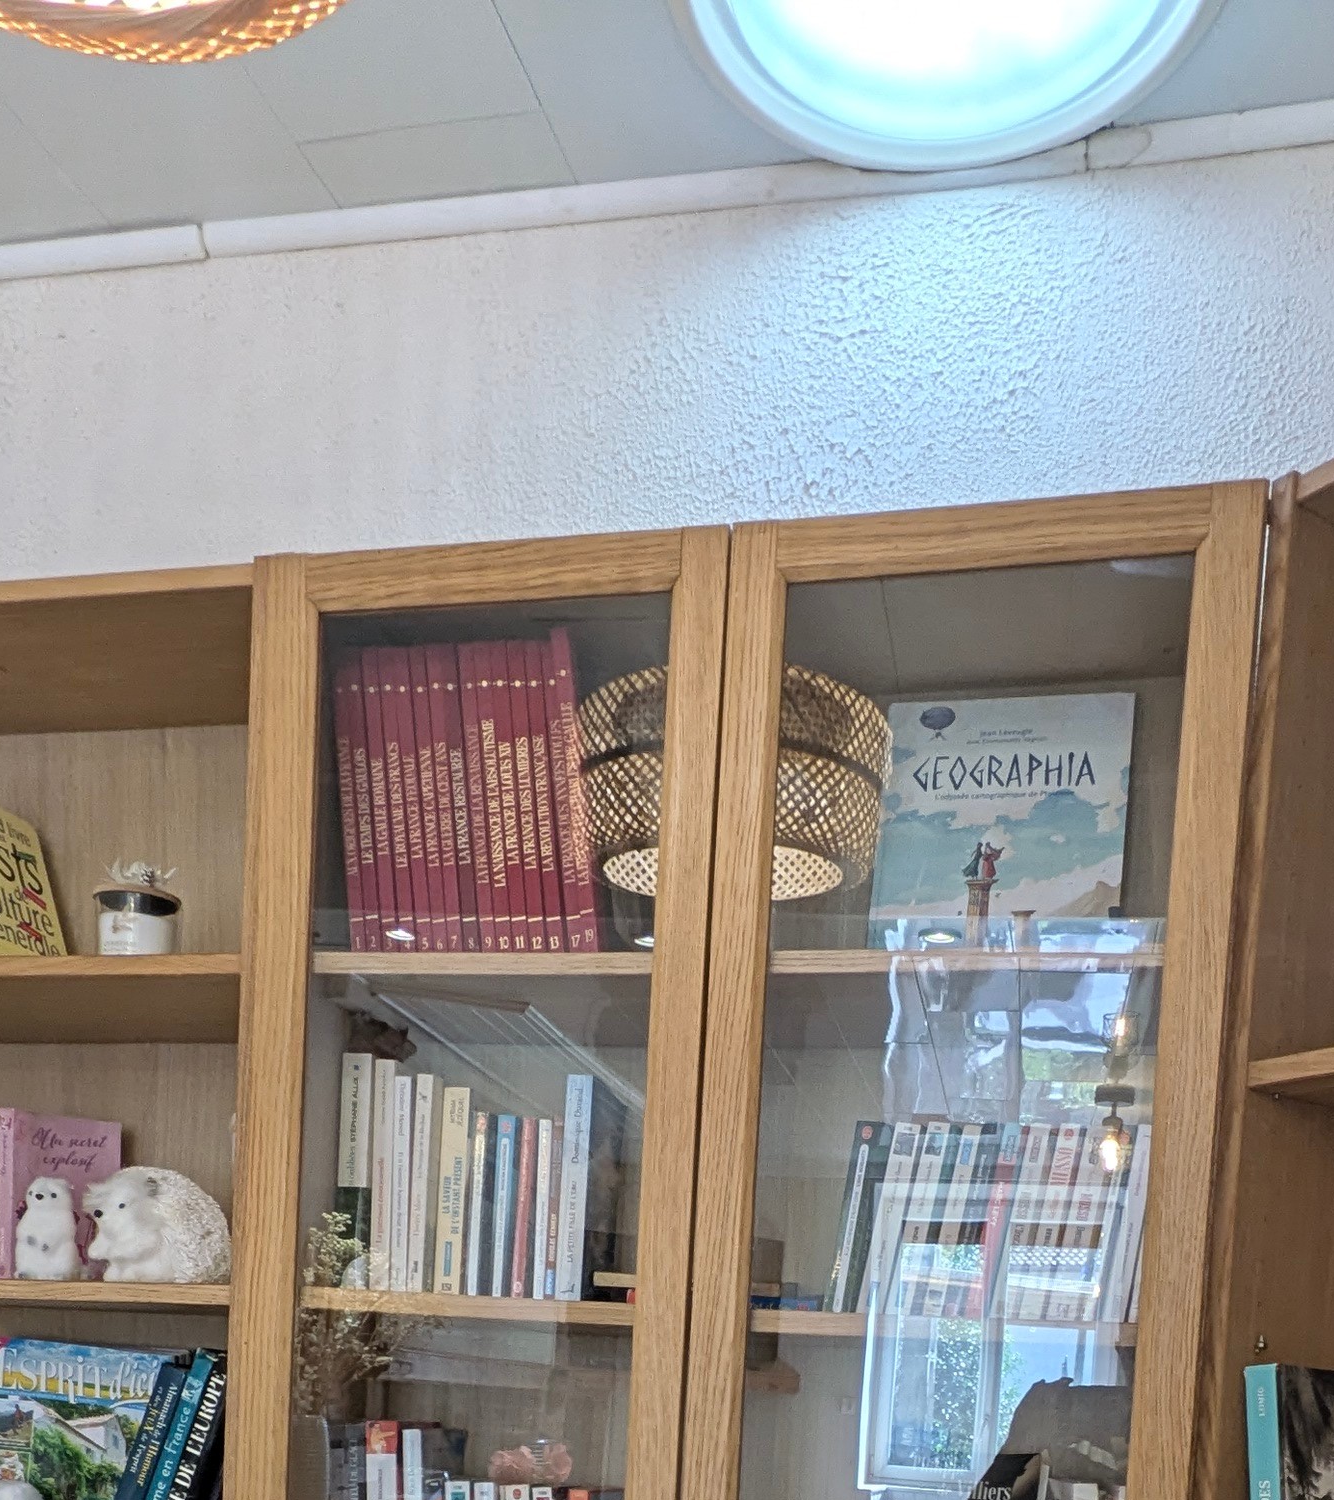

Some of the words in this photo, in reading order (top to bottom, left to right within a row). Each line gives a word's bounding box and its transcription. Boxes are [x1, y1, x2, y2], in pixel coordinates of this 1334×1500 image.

[481, 718, 499, 796] L'ABSOLUTISME
[497, 741, 511, 757] XIV
[353, 746, 368, 792] GAULOIS
[499, 759, 513, 789] LOUIS
[912, 751, 1096, 792] GEOGRAPHIA
[370, 758, 386, 805] ROMAINE
[356, 793, 370, 814] DES
[487, 797, 500, 812] DE
[501, 790, 515, 805] DE
[358, 815, 373, 848] TEMPS
[503, 807, 518, 849] FRANCE
[376, 840, 389, 855] LA
[489, 814, 505, 871] NAISSANCE
[361, 849, 374, 863] LE
[506, 850, 520, 865] LA
[493, 872, 507, 887] LA
[442, 1175, 451, 1203] SAVEUR
[442, 1205, 450, 1214] LA
[449, 1225, 458, 1234] DE
[164, 1405, 191, 1454] France
[174, 1460, 196, 1487] DE
[185, 1369, 227, 1456] L'EUROPE
[161, 1459, 173, 1477] en
